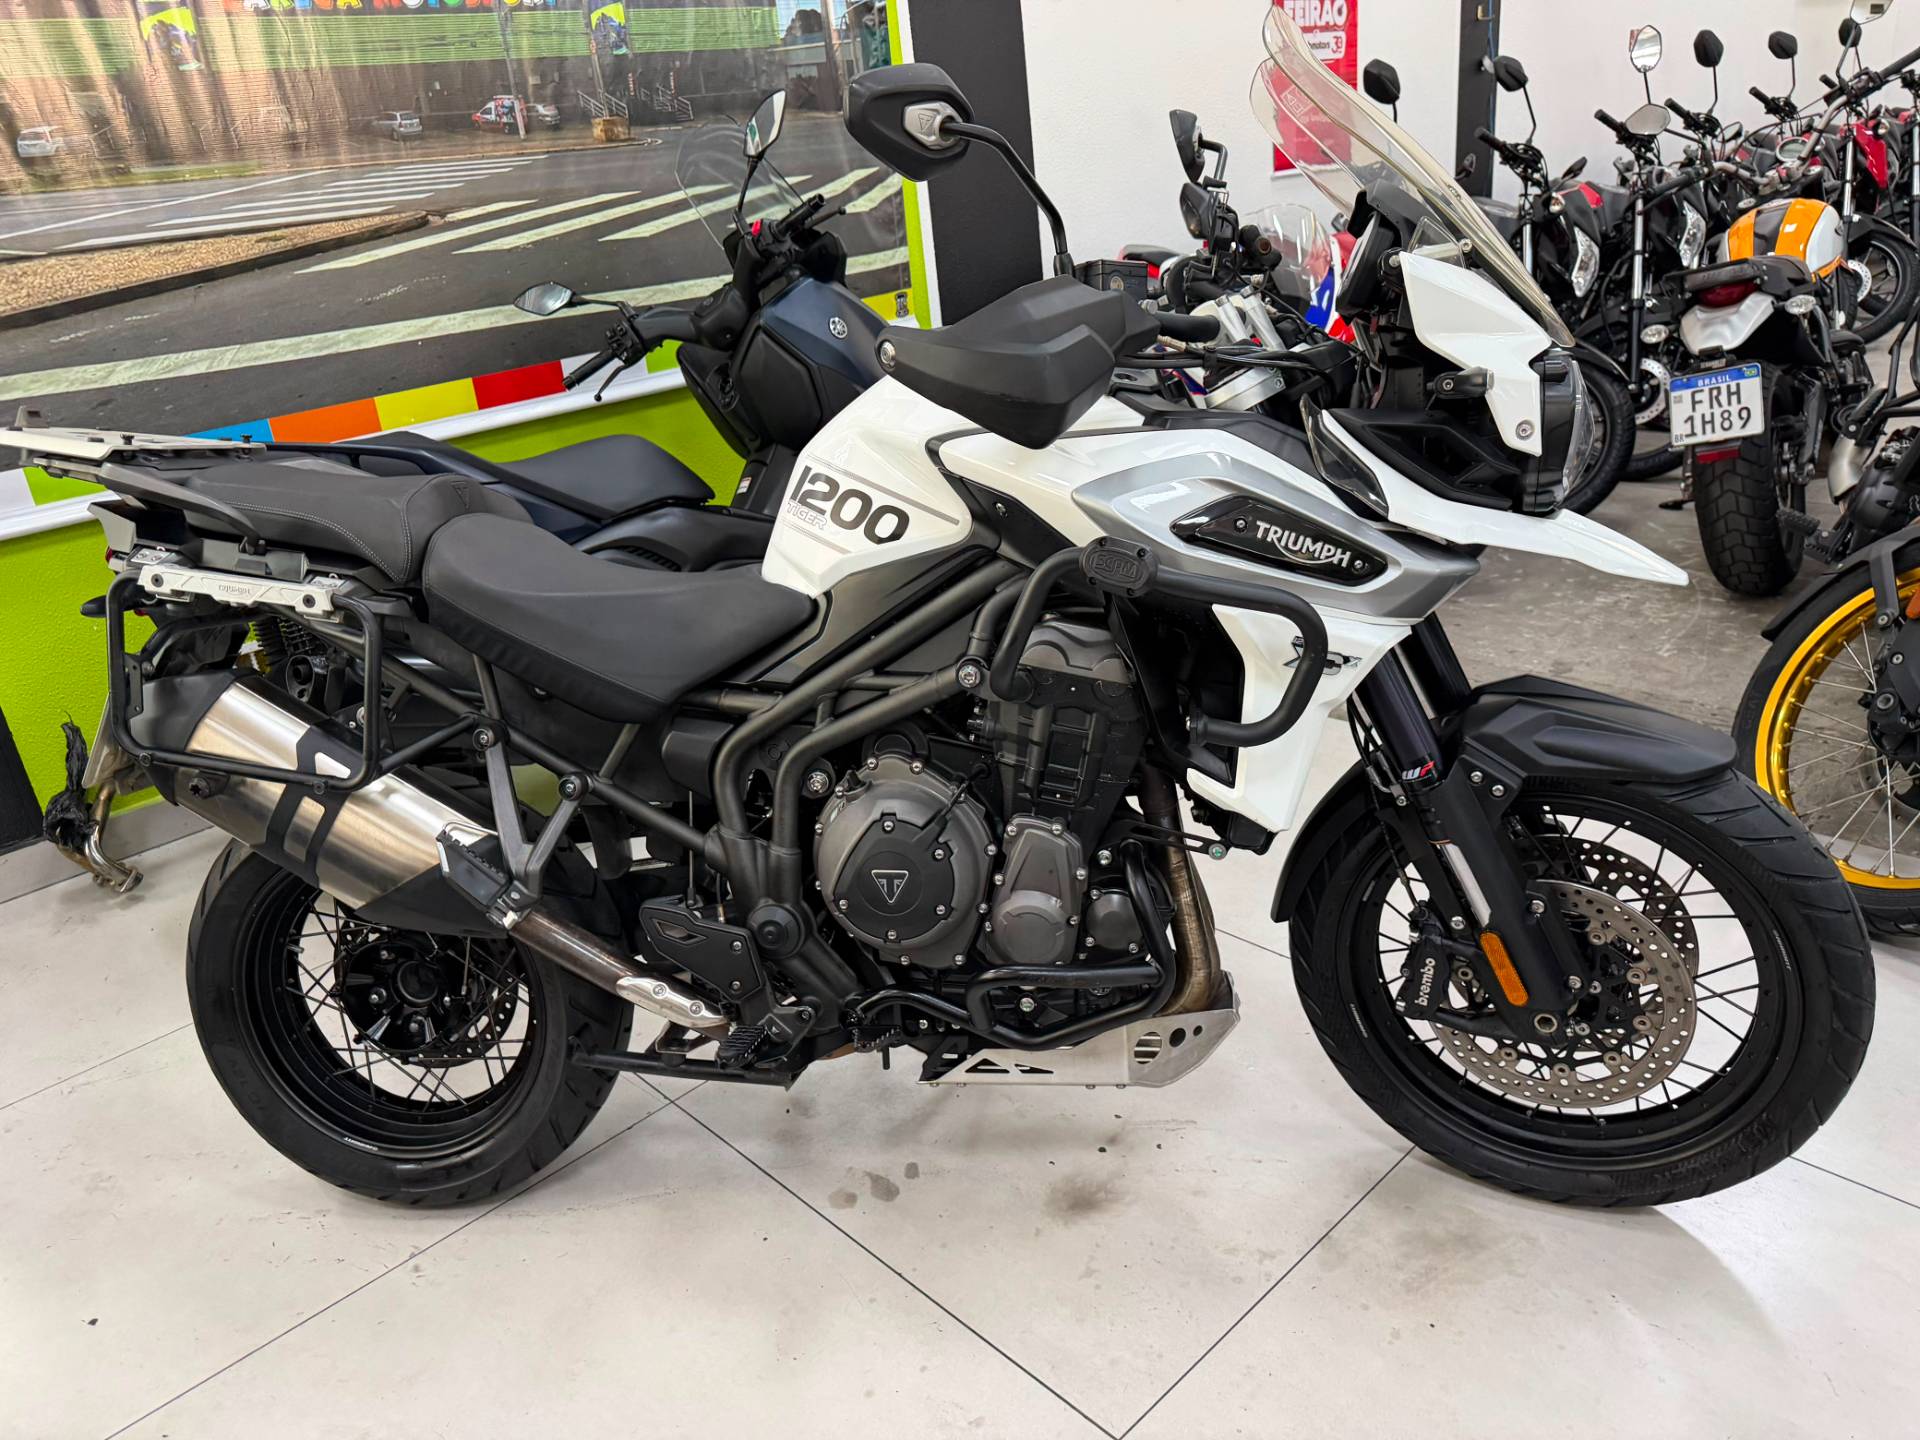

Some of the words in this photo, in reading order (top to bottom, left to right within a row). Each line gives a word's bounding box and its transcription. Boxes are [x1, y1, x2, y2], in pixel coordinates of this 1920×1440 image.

[1697, 374, 1730, 387] BRASIL
[1691, 382, 1741, 413] FRH
[1683, 406, 1752, 438] 1H89
[785, 501, 828, 531] TIGER
[789, 464, 910, 545] 1200
[1256, 519, 1352, 569] TRIUMPH
[1413, 957, 1436, 1007] brembo
